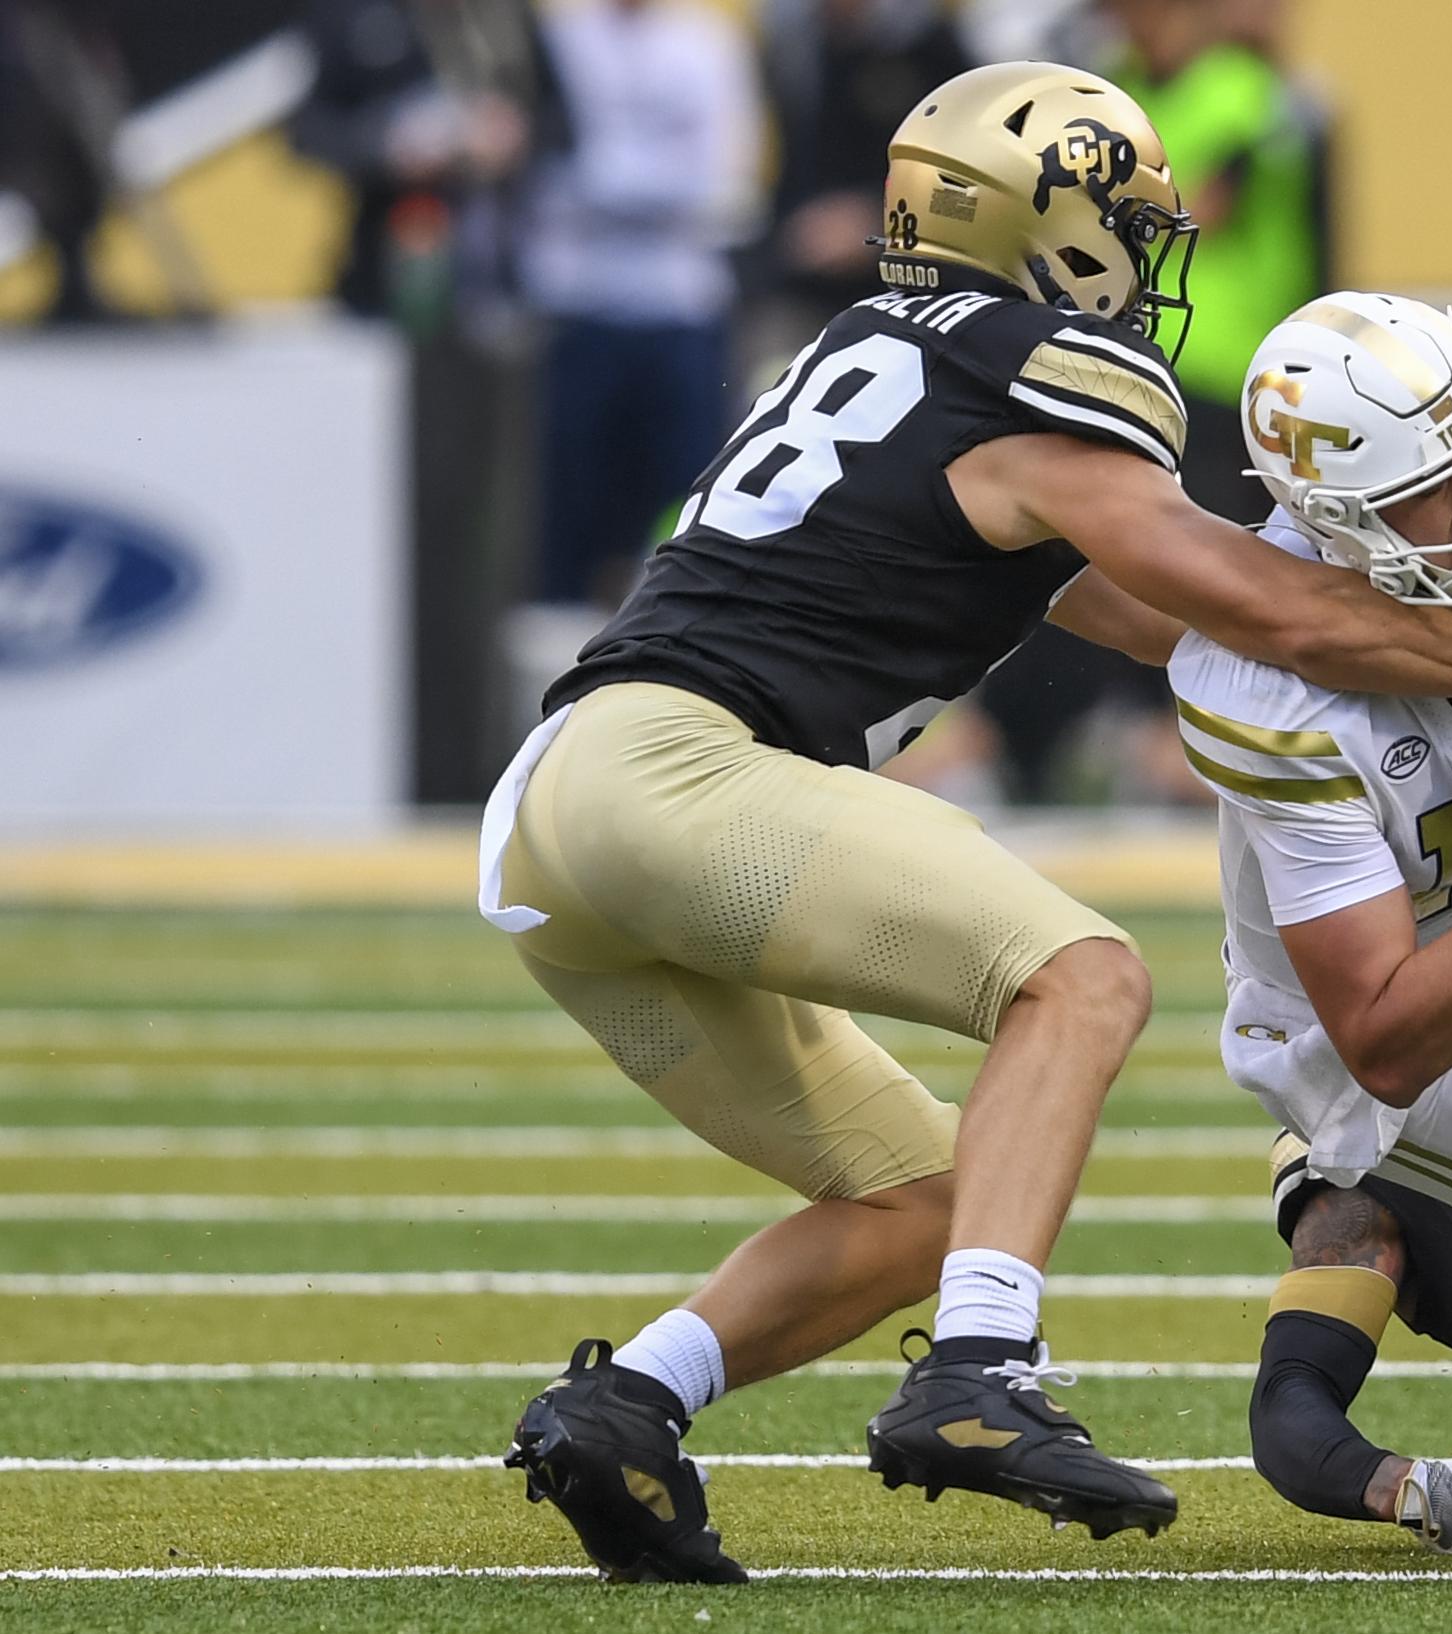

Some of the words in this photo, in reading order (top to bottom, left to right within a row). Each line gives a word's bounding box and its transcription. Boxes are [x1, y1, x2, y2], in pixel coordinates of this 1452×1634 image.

[889, 210, 918, 250] 28
[1248, 369, 1350, 483] GT
[1388, 739, 1422, 768] ACC
